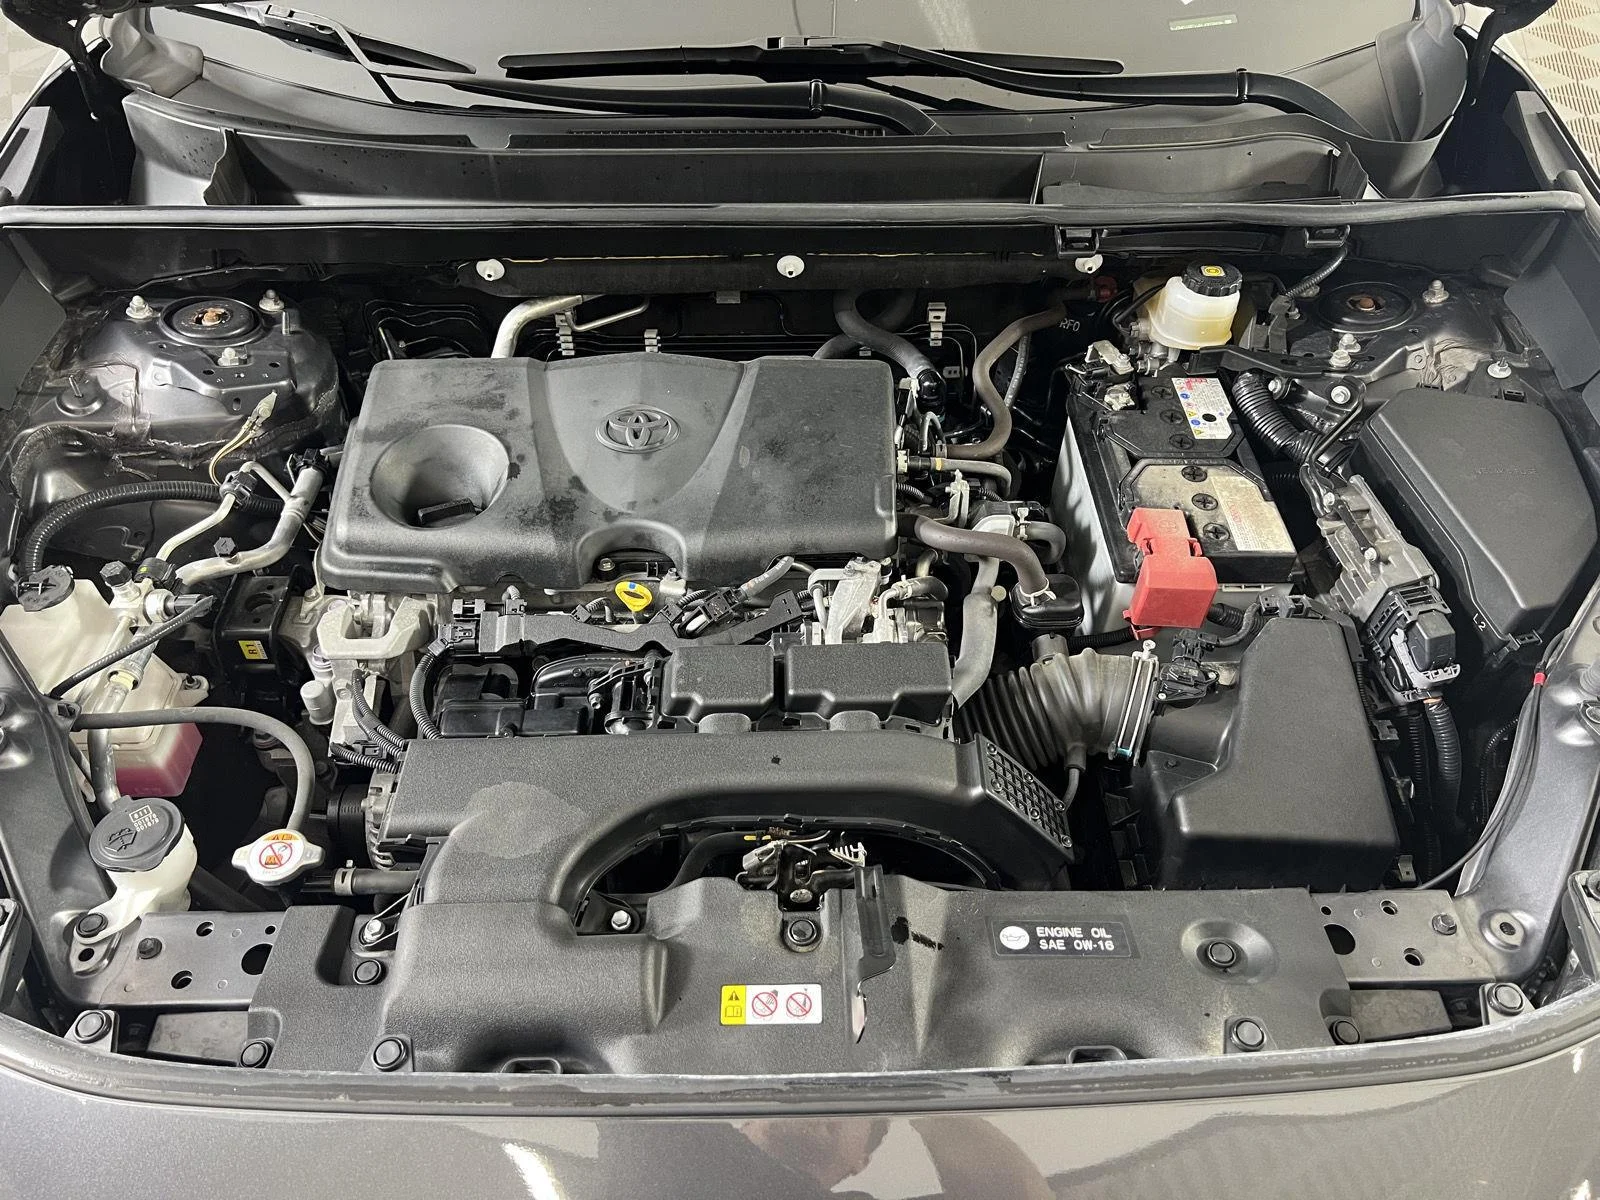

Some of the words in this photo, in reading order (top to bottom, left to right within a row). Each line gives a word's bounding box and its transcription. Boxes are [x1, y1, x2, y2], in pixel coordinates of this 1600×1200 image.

[1035, 926, 1084, 938] ENGINE
[1090, 927, 1113, 939] OIL
[1039, 938, 1067, 951] SAE
